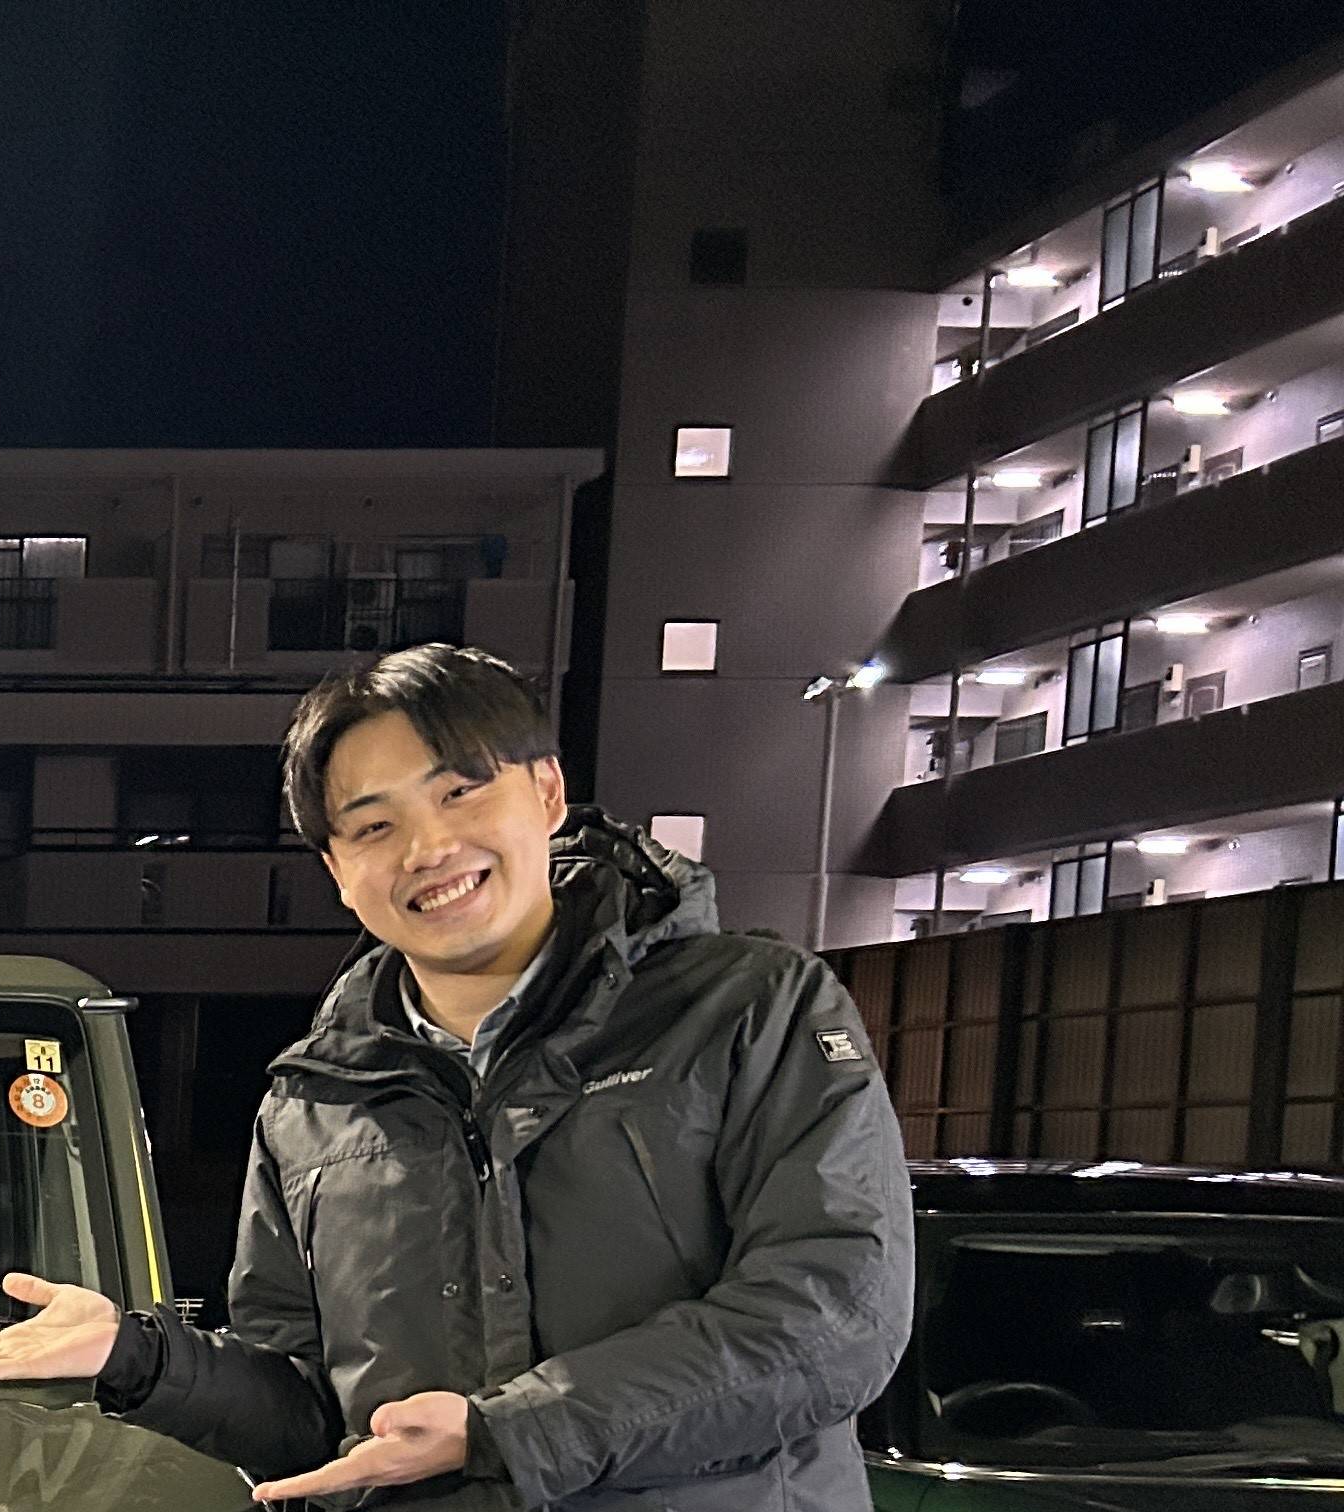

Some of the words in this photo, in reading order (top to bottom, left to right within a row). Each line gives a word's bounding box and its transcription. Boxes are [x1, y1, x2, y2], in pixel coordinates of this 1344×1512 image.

[34, 1056, 54, 1072] 11
[582, 1067, 654, 1094] Gulliver
[32, 1093, 45, 1109] 8
